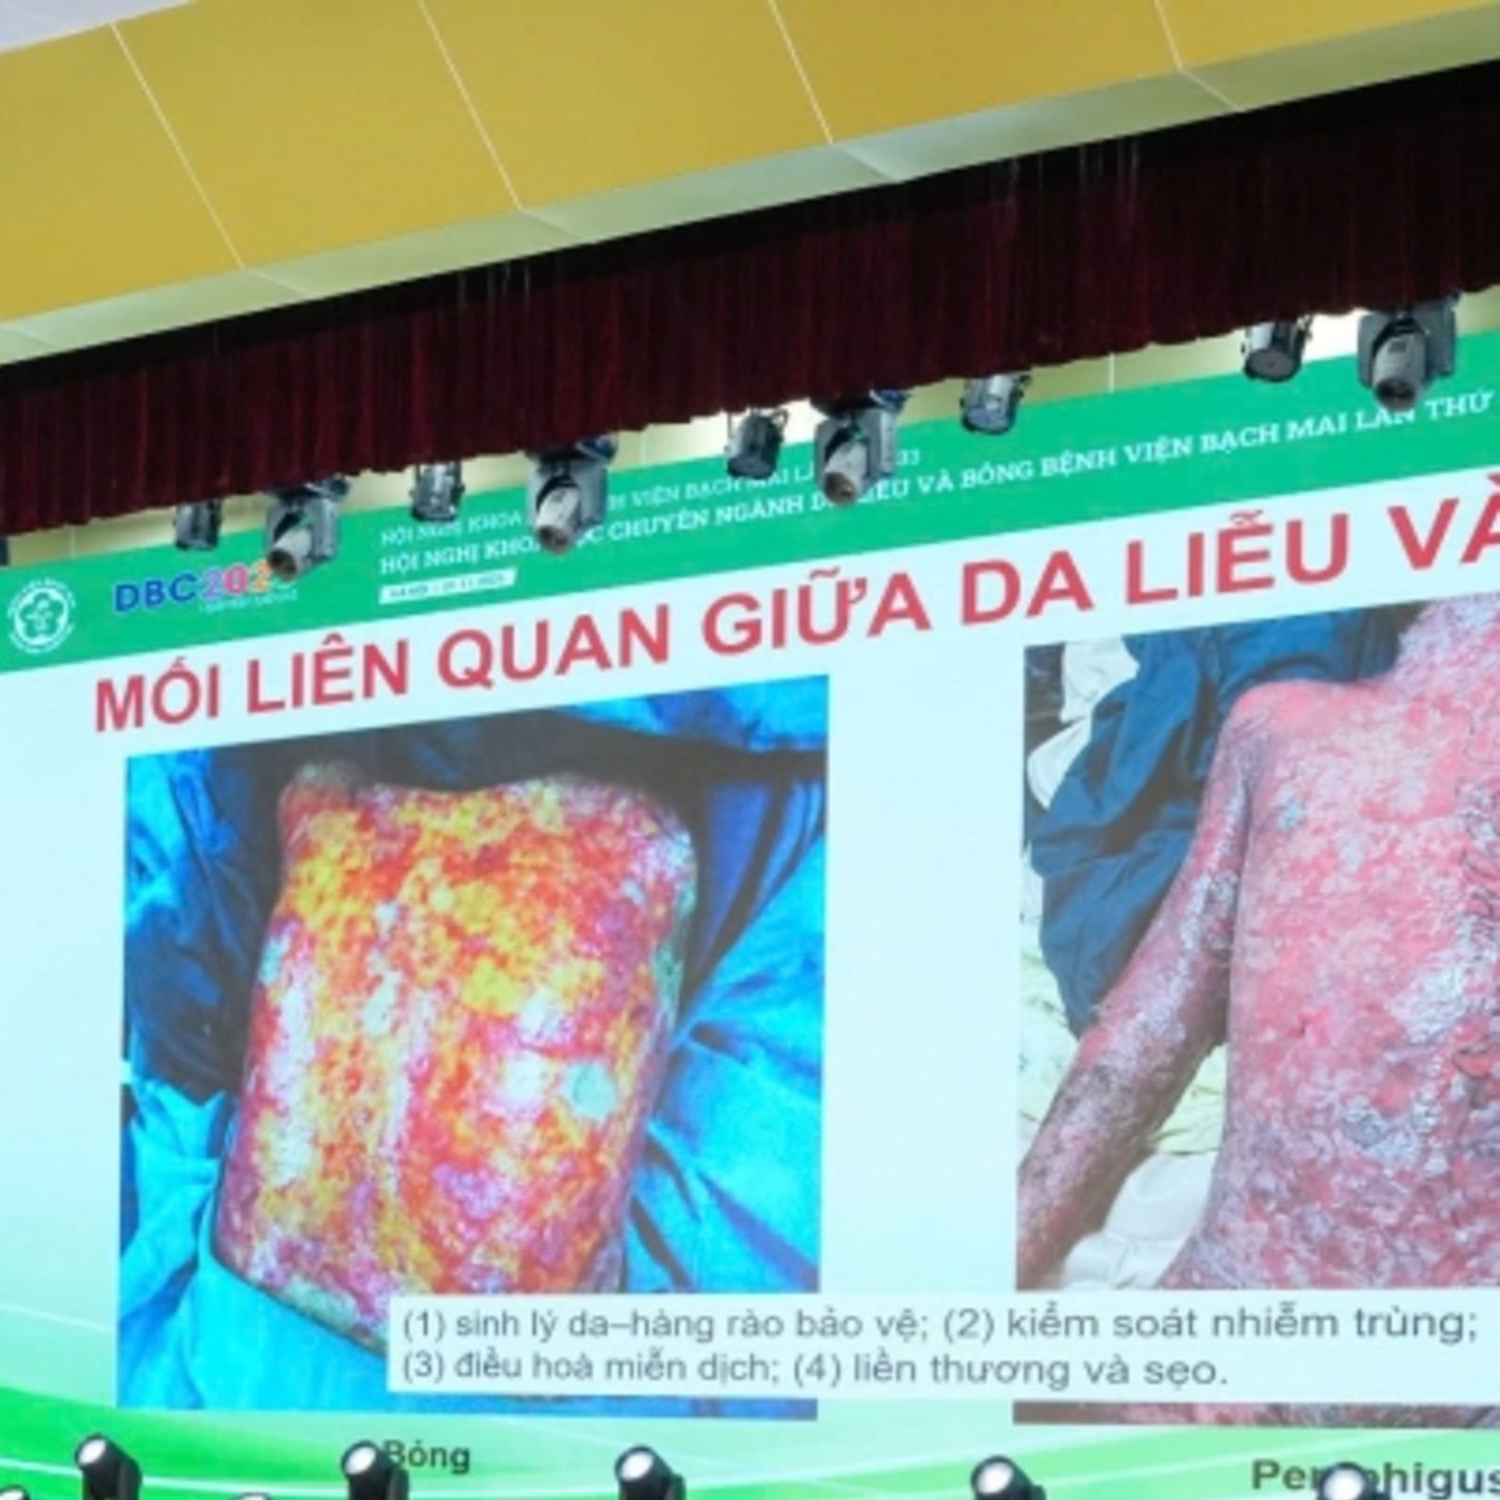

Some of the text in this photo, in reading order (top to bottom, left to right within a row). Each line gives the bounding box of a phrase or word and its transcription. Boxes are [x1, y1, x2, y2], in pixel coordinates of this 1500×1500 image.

[381, 554, 418, 577] HỘI
[423, 543, 478, 568] NGHỊ
[484, 535, 540, 559] KHO
[607, 504, 711, 541] CHUYÊN
[918, 469, 953, 494] VÀ
[1040, 448, 1117, 478] BỆNH
[1122, 434, 1193, 465] VIỆN
[1200, 423, 1280, 455] BẠCH
[1286, 412, 1347, 440] MAI
[94, 656, 222, 735] MỐI
[246, 632, 411, 715] LIÊN
[435, 602, 671, 691] QUAN
[700, 567, 932, 657] GIỮA
[960, 548, 1095, 626] DA
[1124, 510, 1351, 607] LIỄU
[403, 1346, 1227, 1392] (3) điều hoà miễn dịch; (4) liền thương và sẹo.
[404, 1310, 446, 1342] (1)
[456, 1310, 519, 1336] sinh
[532, 1310, 557, 1343] lý
[727, 1309, 784, 1337] rào
[796, 1307, 863, 1338] bảo
[875, 1308, 927, 1343] vệ;
[944, 1308, 994, 1343] (2)
[1008, 1301, 1099, 1337] kiểm
[1113, 1308, 1197, 1338] soát
[1212, 1301, 1339, 1337] nhiễm
[1355, 1306, 1476, 1345] trùng;
